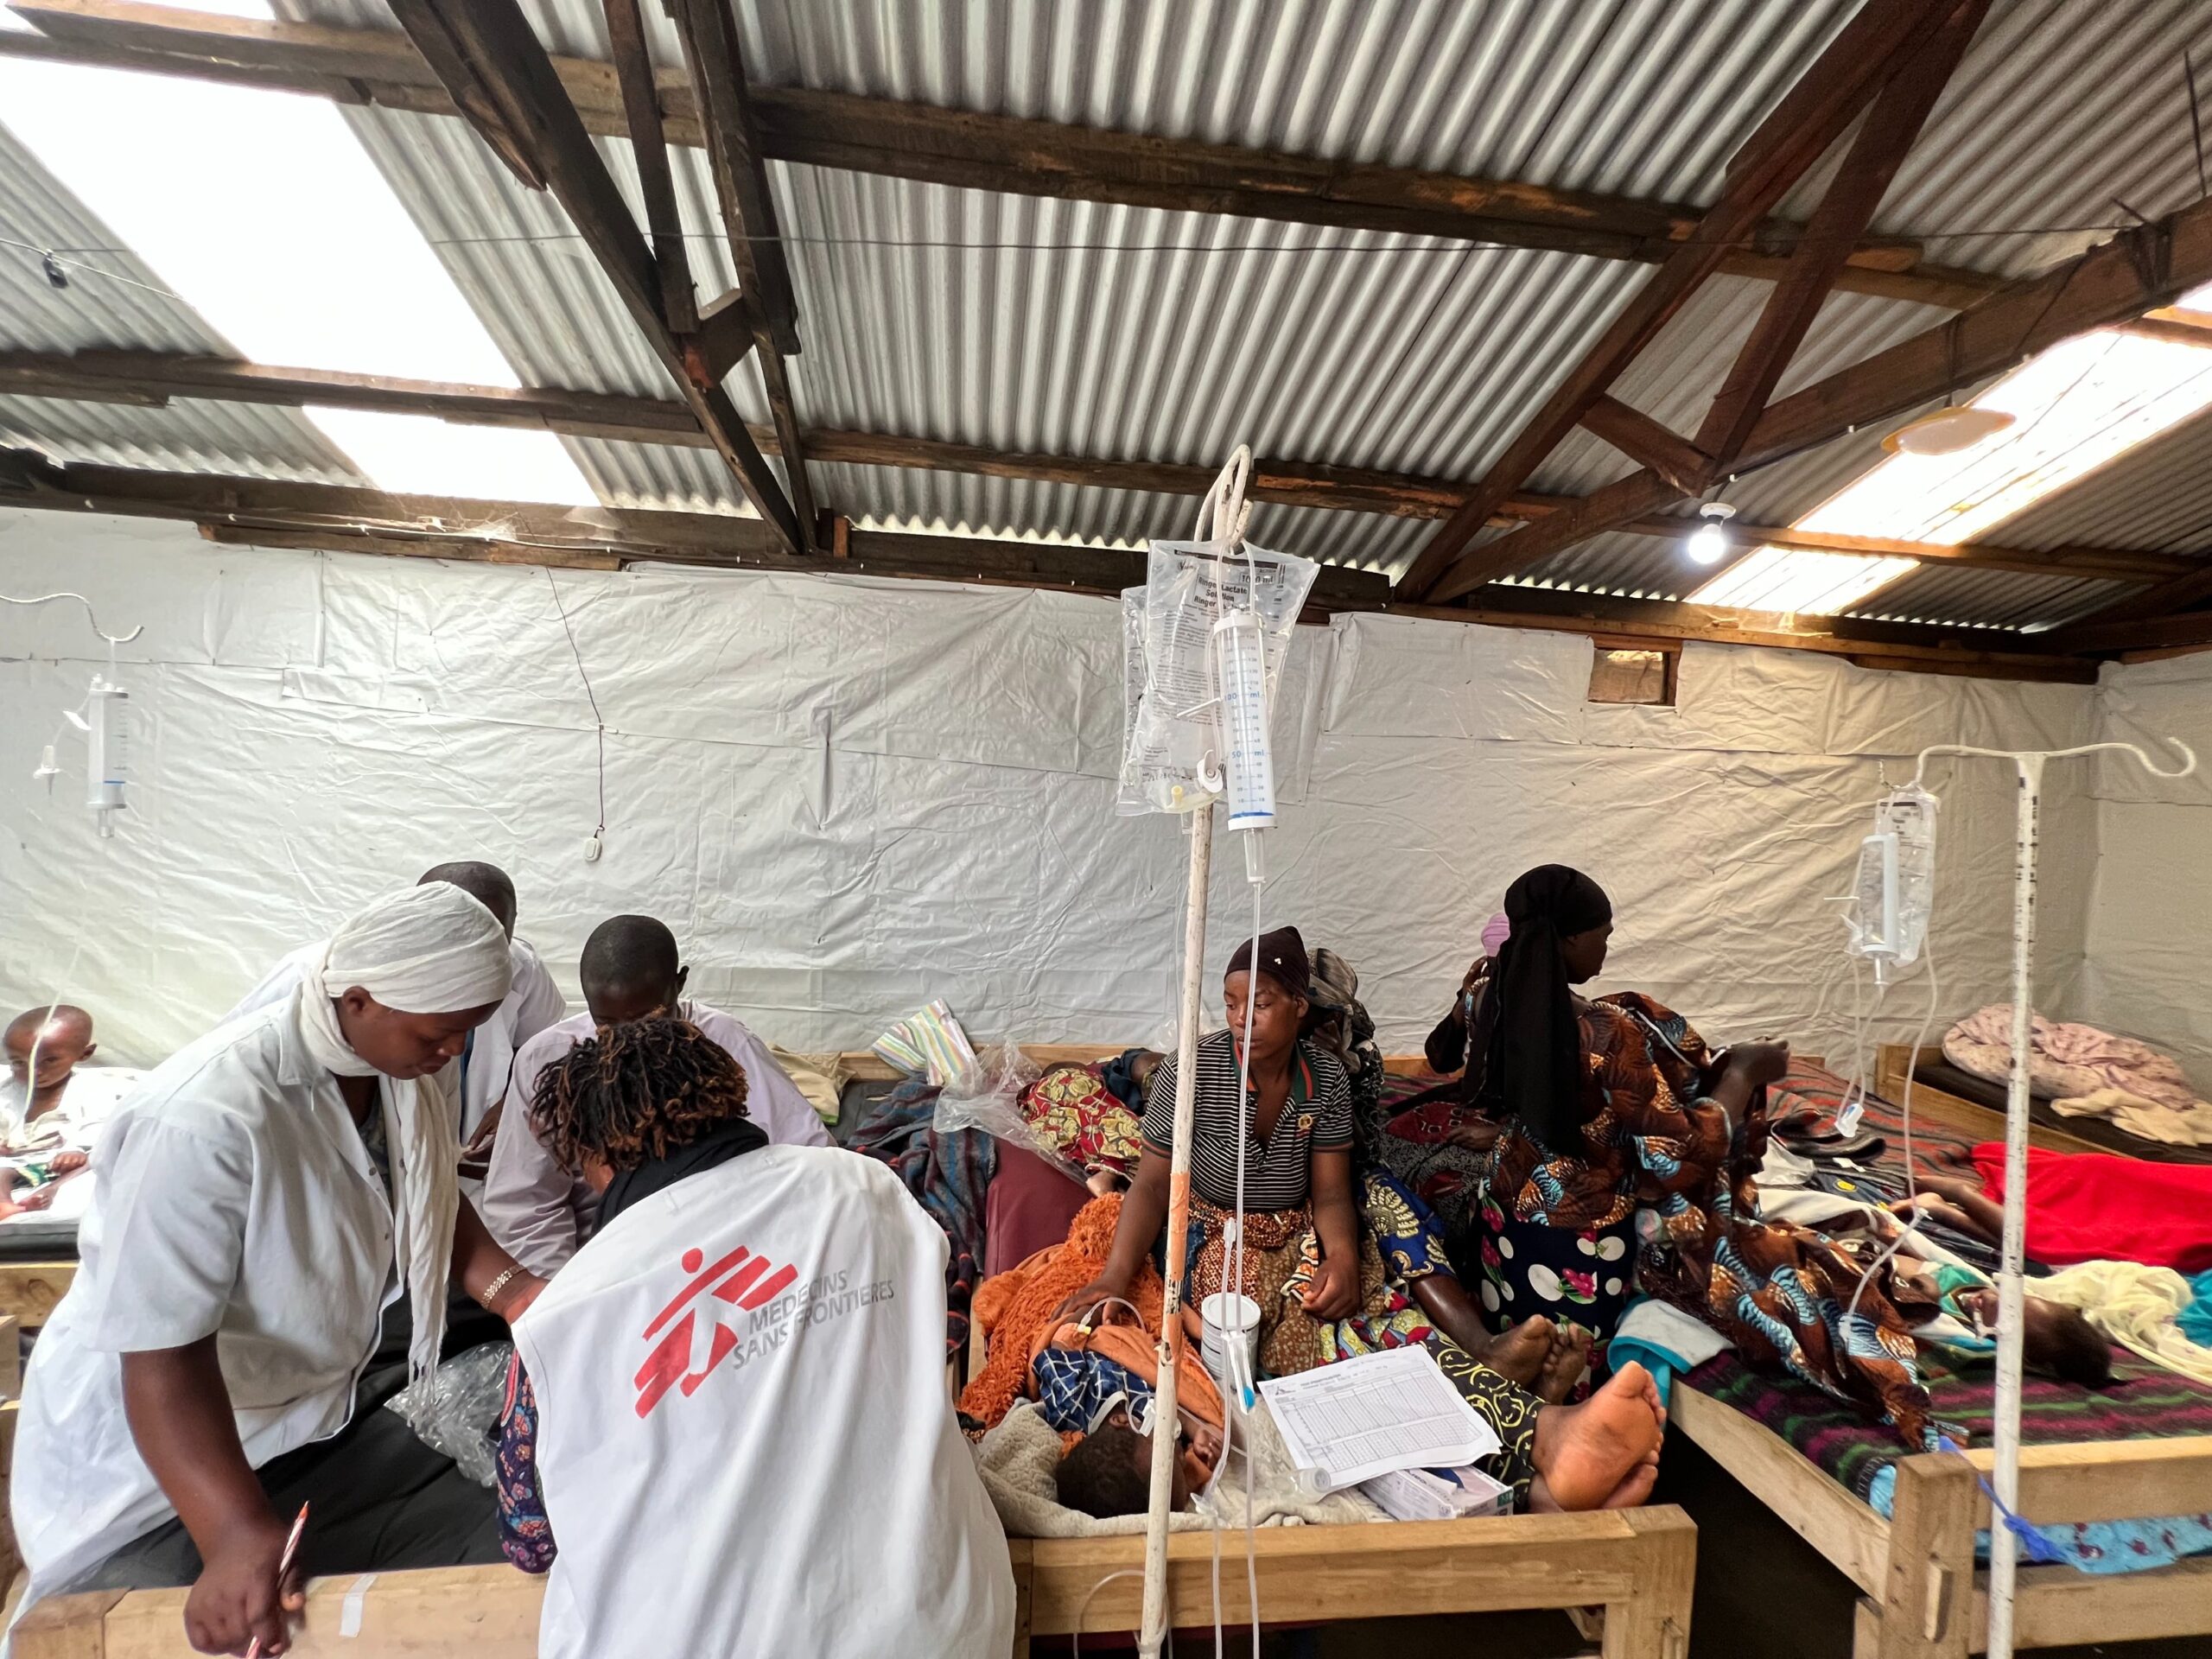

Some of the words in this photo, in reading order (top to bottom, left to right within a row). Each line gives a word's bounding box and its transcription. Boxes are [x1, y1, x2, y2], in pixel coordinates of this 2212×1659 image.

[1198, 576, 1219, 589] Ringe
[1221, 583, 1248, 594] Lactate
[1242, 575, 1261, 583] 100
[1193, 595, 1217, 607] Ringer
[1205, 589, 1235, 602] Soltion
[1224, 692, 1237, 702] 100
[1231, 750, 1242, 760] 50
[1254, 748, 1264, 757] ml
[748, 1269, 849, 1335] MEDECINS
[733, 1321, 789, 1370] SANS
[793, 1280, 894, 1332] FRONTIERES
